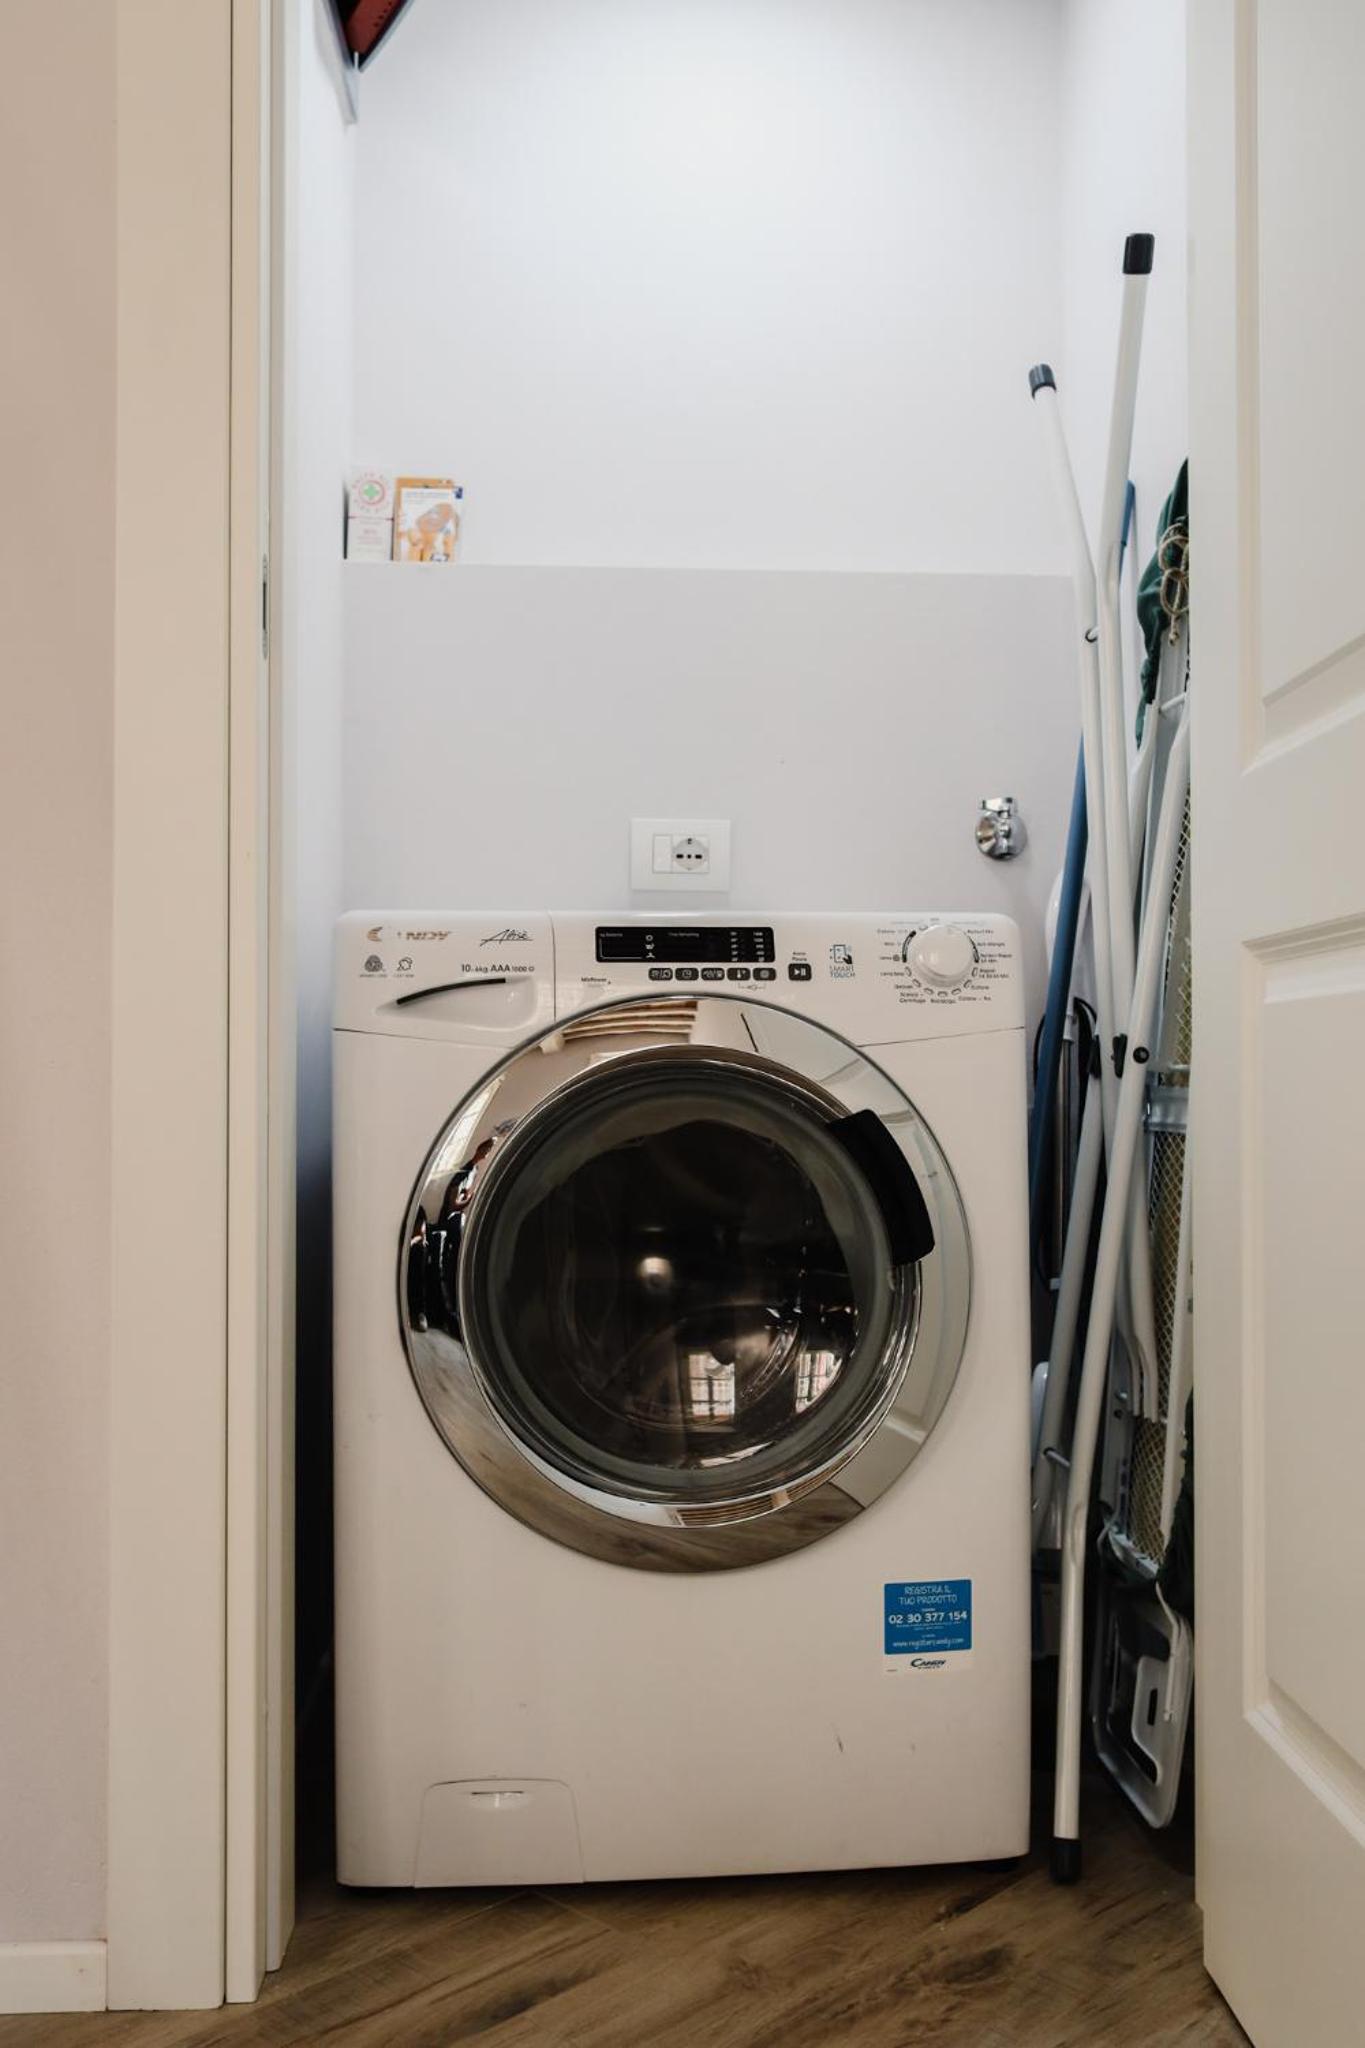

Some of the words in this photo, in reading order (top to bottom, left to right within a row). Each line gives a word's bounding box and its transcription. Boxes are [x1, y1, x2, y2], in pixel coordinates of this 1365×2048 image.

[490, 963, 511, 973] AAA
[904, 1585, 943, 1595] REGISTRA
[898, 1596, 915, 1605] TUO
[917, 1594, 958, 1605] PRODOTTO
[888, 1614, 904, 1625] 02
[906, 1613, 922, 1623] 30
[924, 1612, 945, 1623] 377
[948, 1610, 968, 1622] 154
